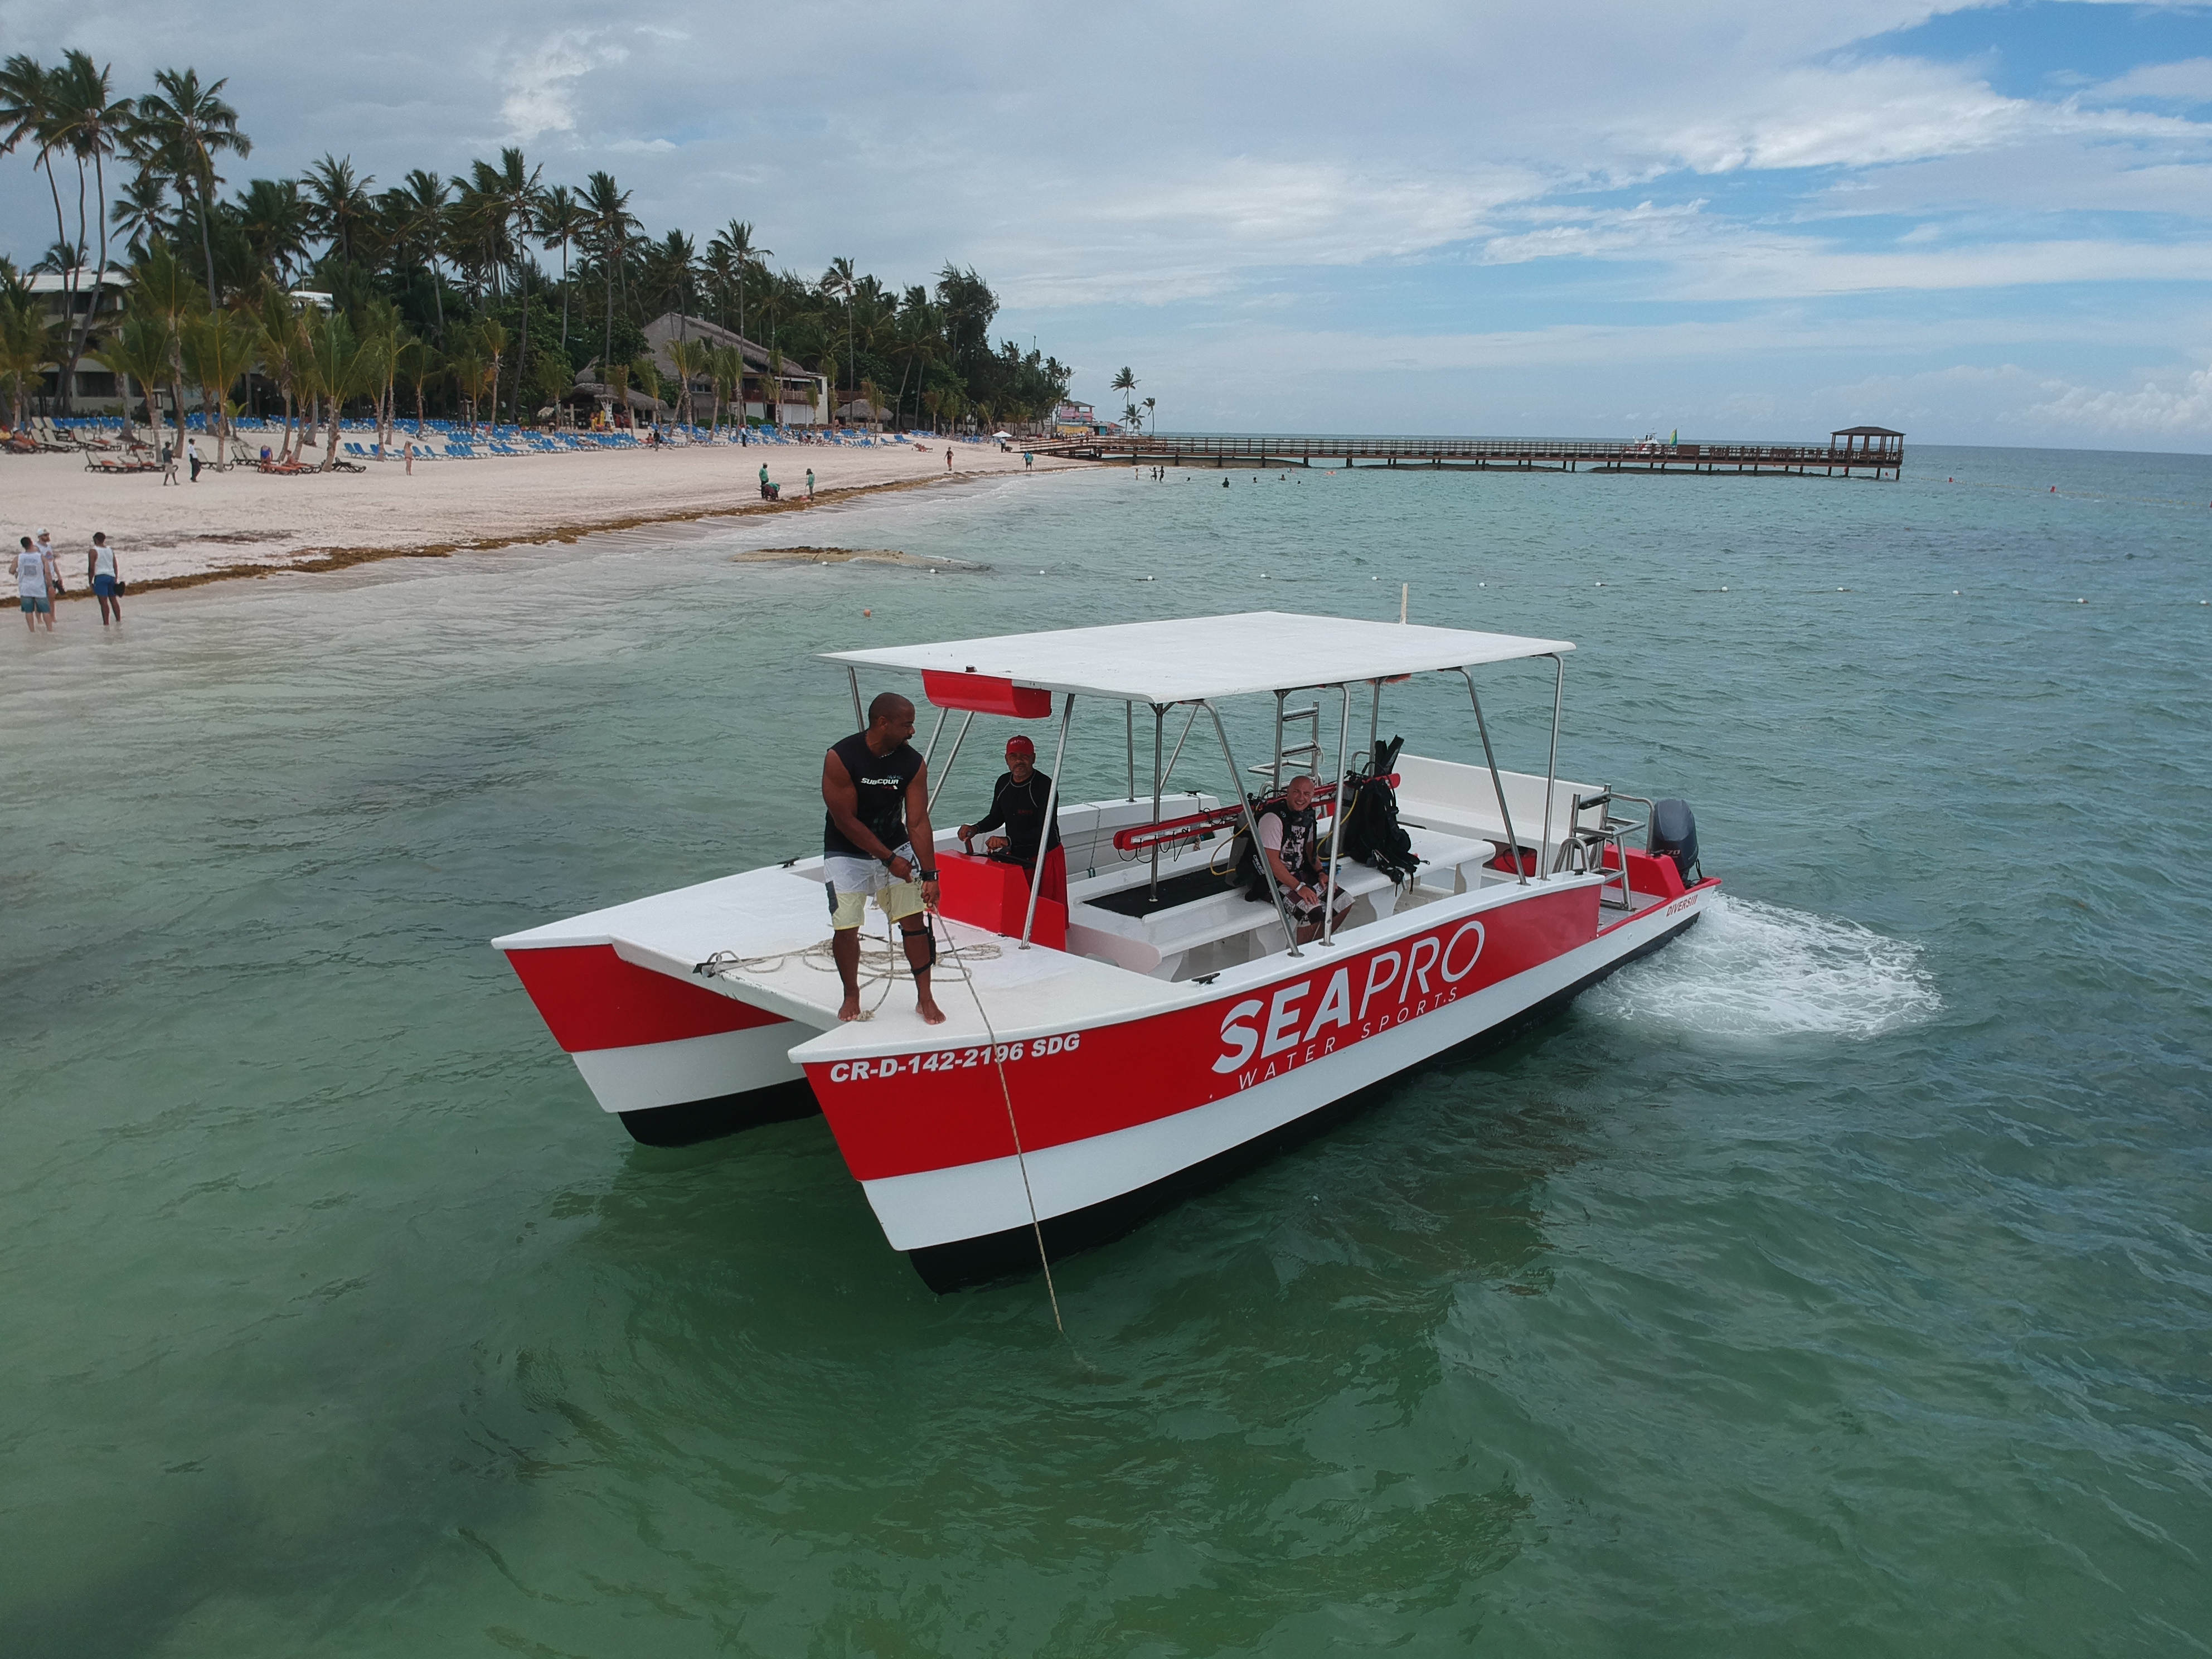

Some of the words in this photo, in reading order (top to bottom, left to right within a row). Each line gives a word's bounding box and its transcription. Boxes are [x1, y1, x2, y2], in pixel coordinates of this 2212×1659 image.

[1211, 920, 1485, 1074] SEAPRO
[1239, 1037, 1335, 1090] WATER
[1361, 987, 1457, 1039] SPORTS
[830, 1043, 1023, 1083] CR-D-142-2196
[1031, 1034, 1080, 1057] SDG
